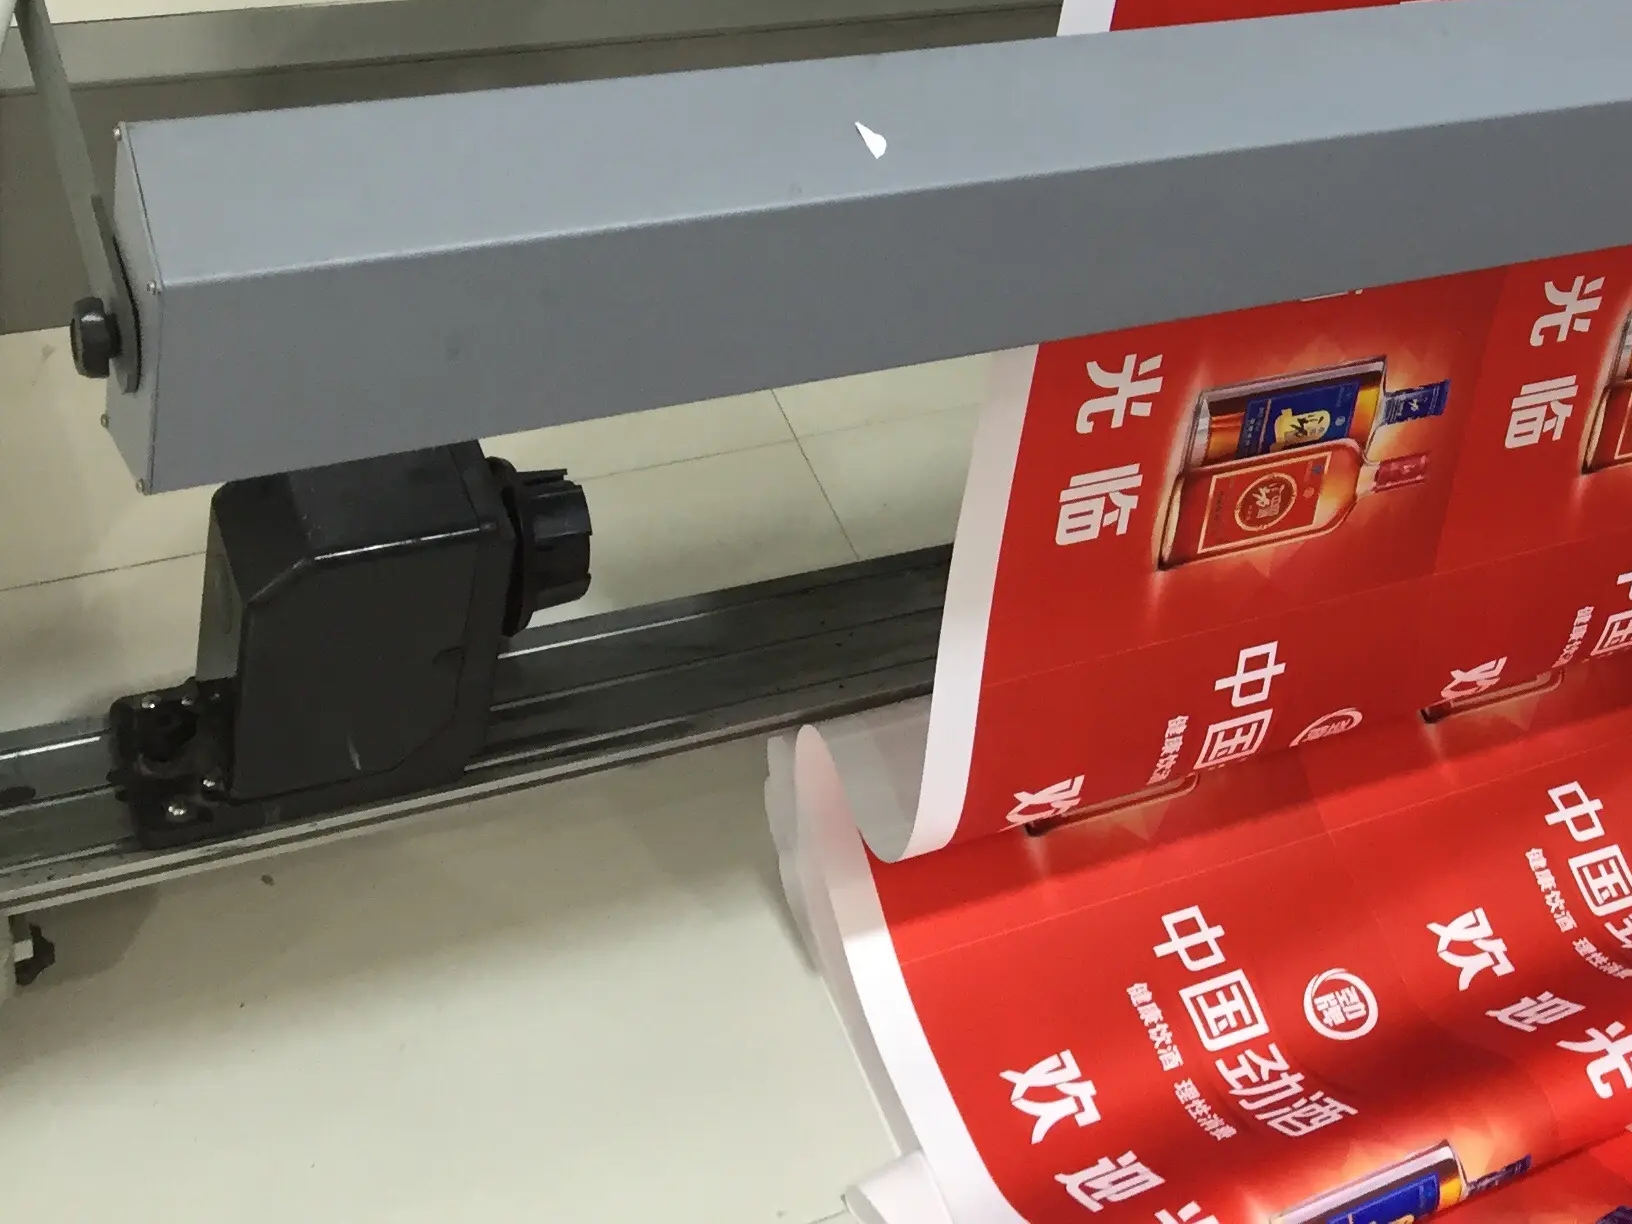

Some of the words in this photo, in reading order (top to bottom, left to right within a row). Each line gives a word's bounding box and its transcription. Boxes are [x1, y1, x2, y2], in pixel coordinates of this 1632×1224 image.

[1505, 276, 1604, 448] 光临
[1056, 354, 1163, 545] 光临
[1194, 641, 1285, 769] 中国
[1526, 849, 1576, 931] 健康饮酒
[1127, 983, 1183, 1071] 健康饮酒
[1174, 1079, 1236, 1140] 理性消费
[1153, 905, 1358, 1136] 中国劲酒
